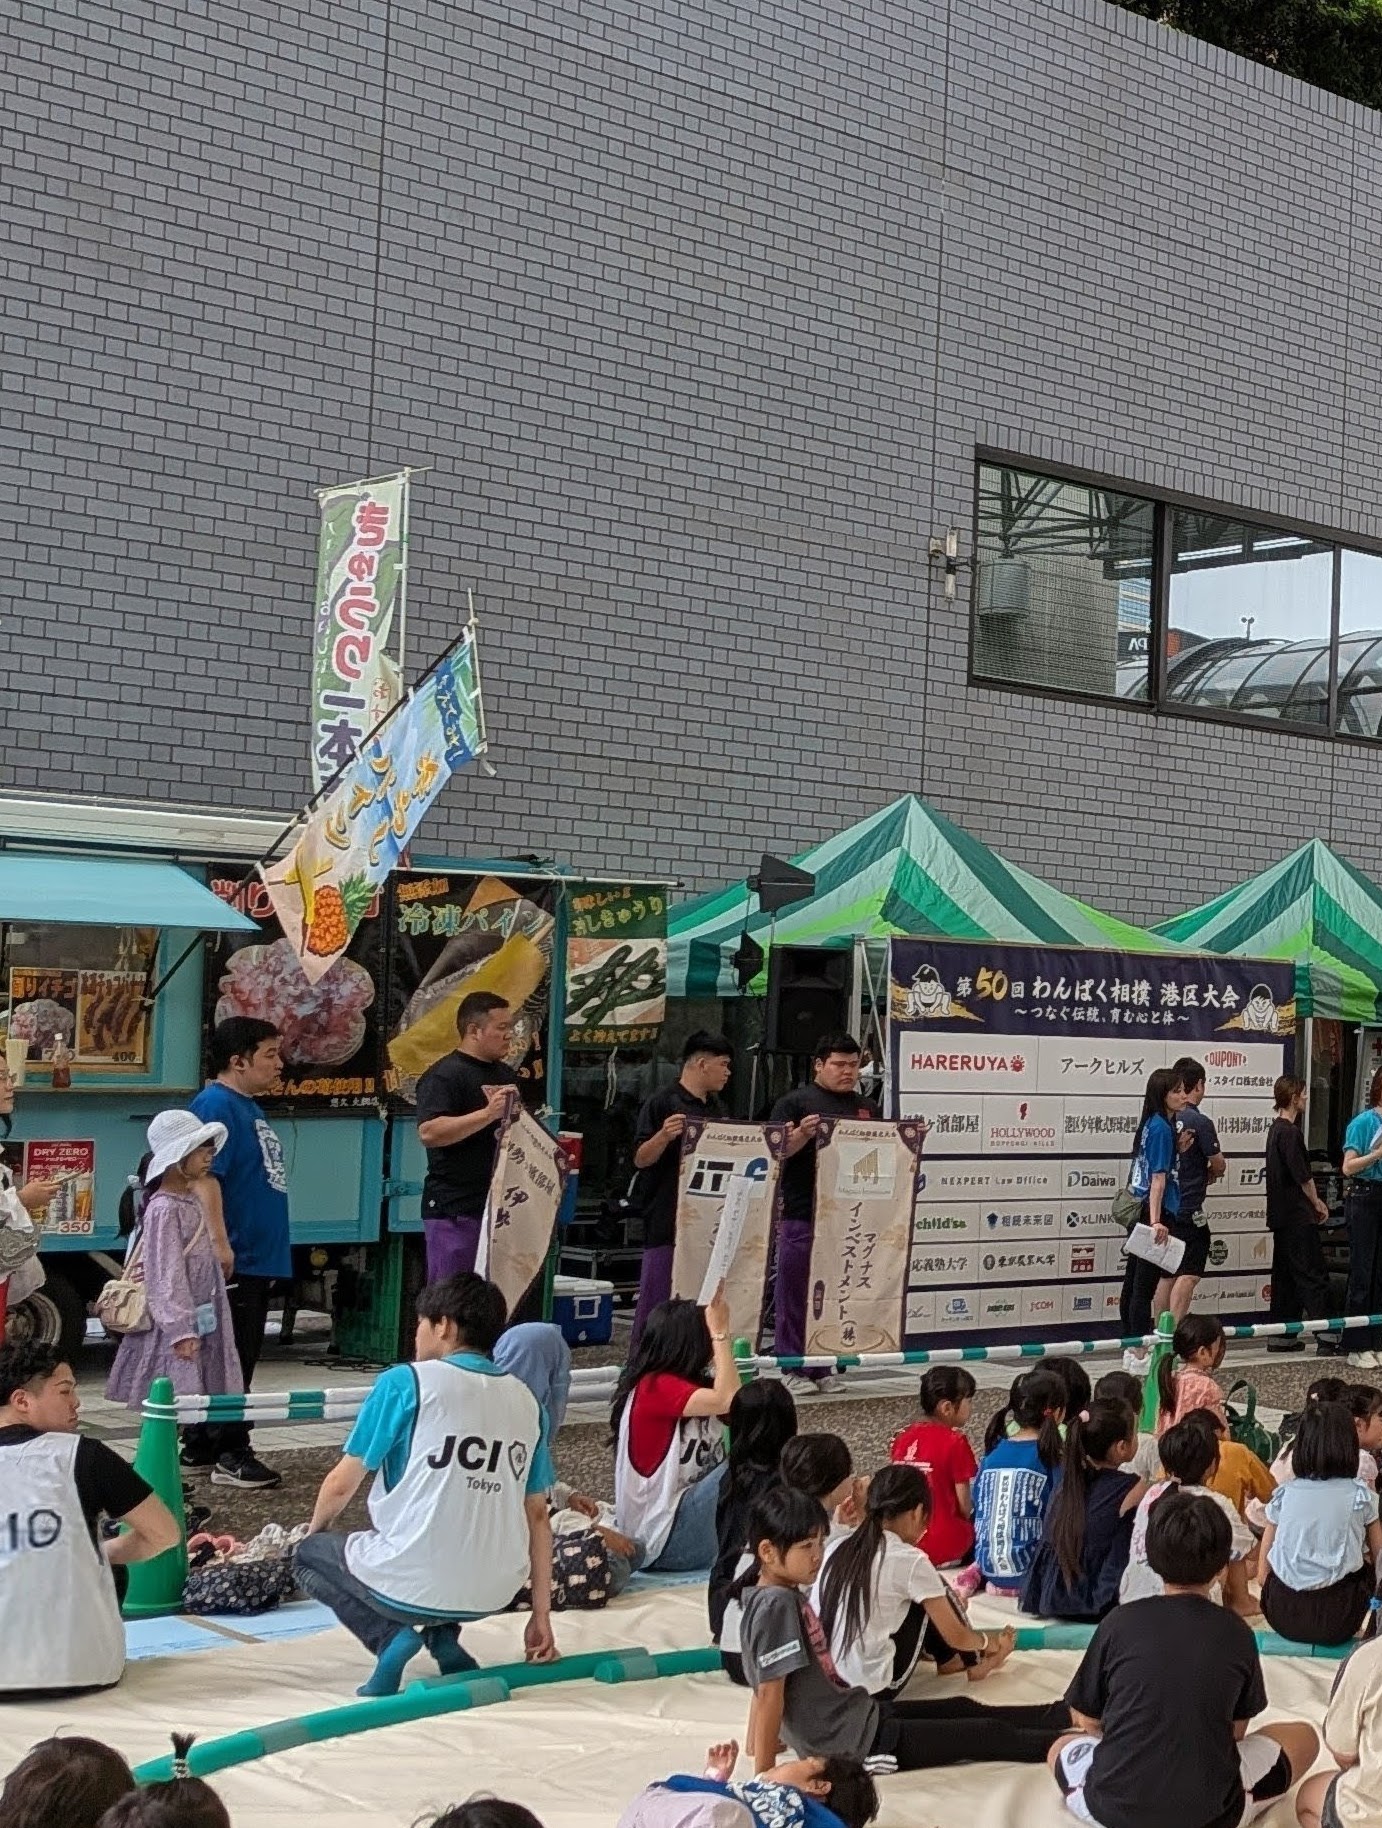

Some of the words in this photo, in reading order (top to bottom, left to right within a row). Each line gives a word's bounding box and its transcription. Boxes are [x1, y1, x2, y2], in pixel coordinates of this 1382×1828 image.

[956, 966, 1025, 1000] 第50回
[1033, 975, 1152, 1007] わんぱく相撲
[1161, 981, 1240, 1009] 港区大会
[911, 1053, 1009, 1071] HARERUYA
[1061, 1057, 1145, 1075] アークヒルズ
[1209, 1050, 1244, 1067] DUPONT
[991, 1127, 1056, 1139] HOLLYWOOD
[33, 1148, 57, 1157] DRY
[59, 1148, 89, 1156] ZERO
[1081, 1174, 1116, 1187] Daiwa
[60, 1222, 91, 1233] 350
[856, 1233, 877, 1288] マグナス
[427, 1434, 503, 1473] JCI
[465, 1476, 502, 1495] Tokyo
